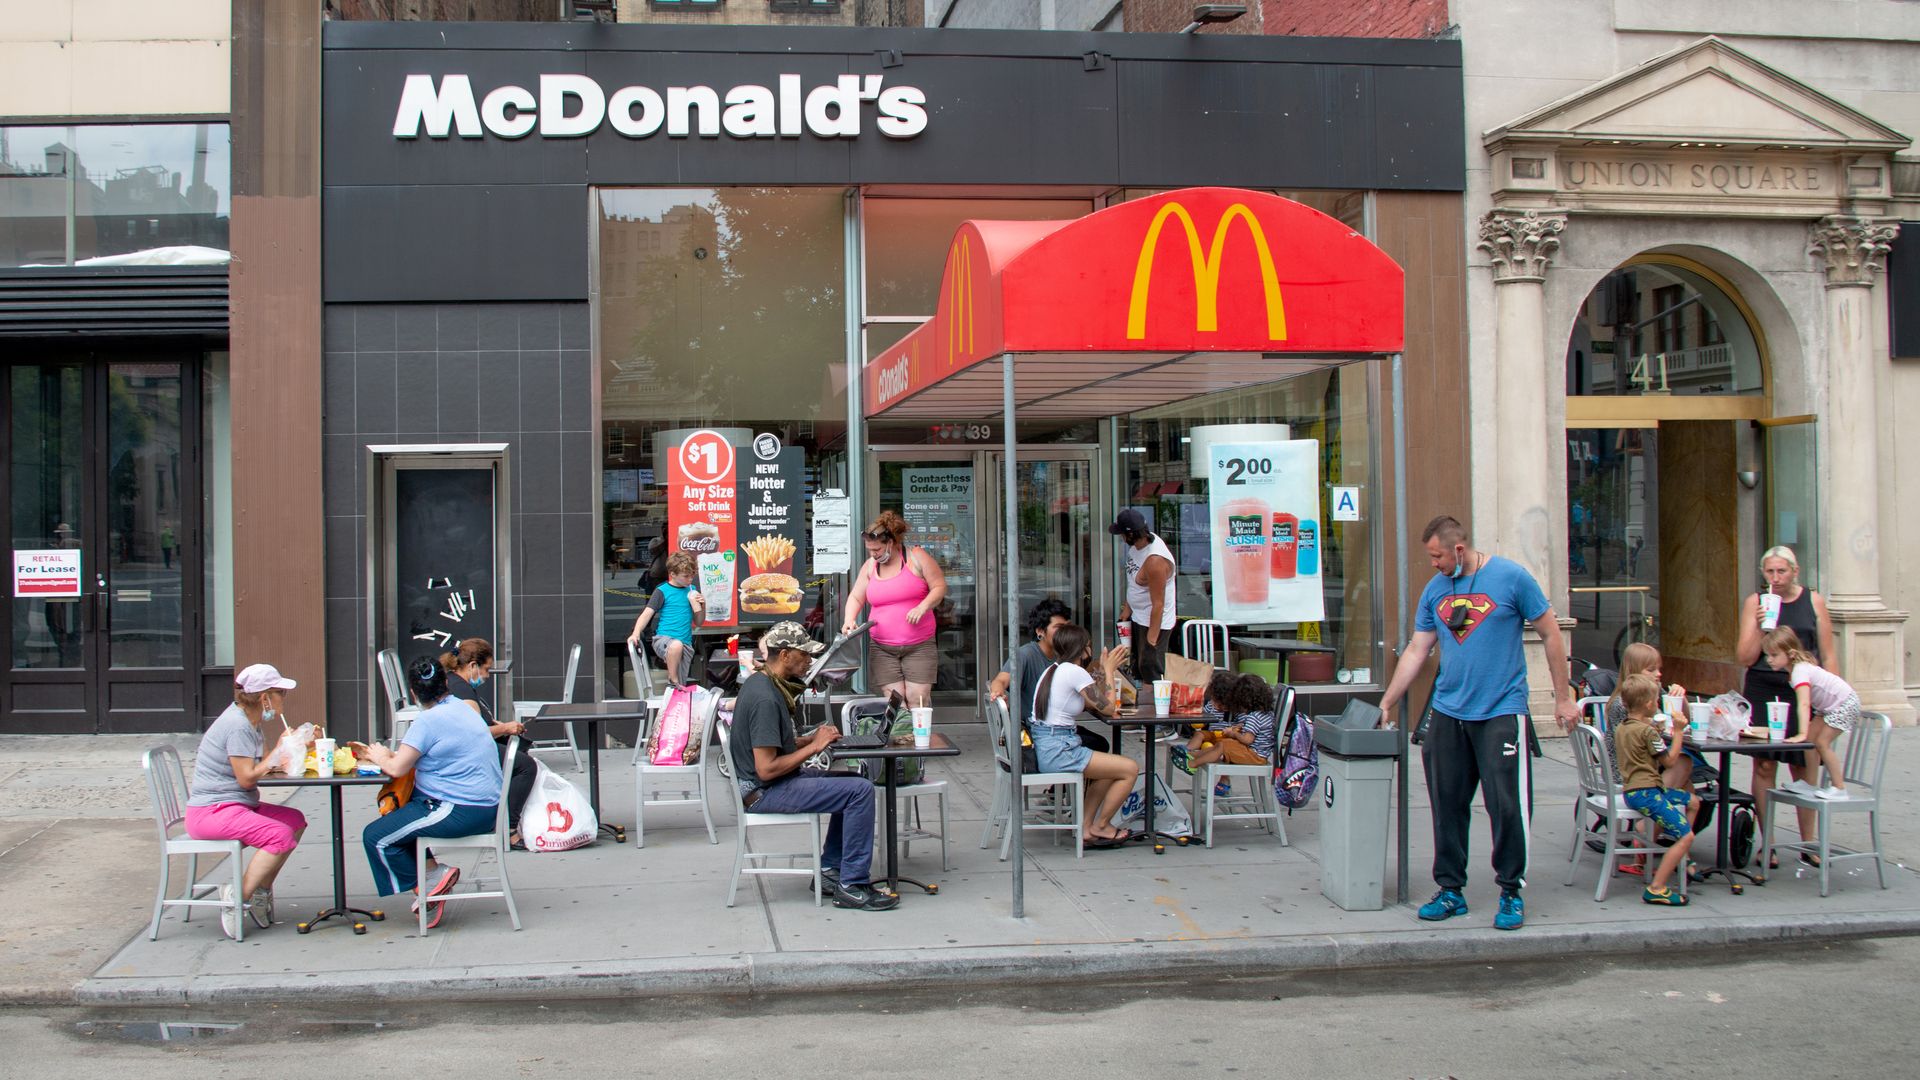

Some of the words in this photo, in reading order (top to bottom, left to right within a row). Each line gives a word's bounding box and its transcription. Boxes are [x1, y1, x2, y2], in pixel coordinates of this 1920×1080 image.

[392, 73, 928, 139] McDonald's
[1565, 160, 1674, 187] UNION
[1690, 163, 1821, 194] SQUARE
[1631, 352, 1669, 392] 41
[970, 424, 991, 440] 39
[688, 442, 718, 474] $1
[755, 464, 779, 474] NEW!
[750, 477, 786, 490] Hotter
[910, 474, 971, 483] Contactless
[683, 485, 705, 501] Any
[708, 485, 735, 499] Size
[910, 485, 939, 493] Order
[940, 484, 948, 493] &
[951, 484, 969, 494] Pay
[763, 490, 772, 503] &
[1338, 491, 1355, 512] A
[688, 501, 706, 511] Soft
[707, 501, 730, 511] Drink
[940, 502, 949, 510] in
[1231, 520, 1260, 529] Minute
[1235, 527, 1256, 535] Maid
[680, 536, 717, 551] Coca-Cola
[1225, 535, 1267, 547] SLUSHIE
[18, 565, 38, 573] For
[41, 565, 76, 573] Lease
[703, 564, 719, 572] MIX
